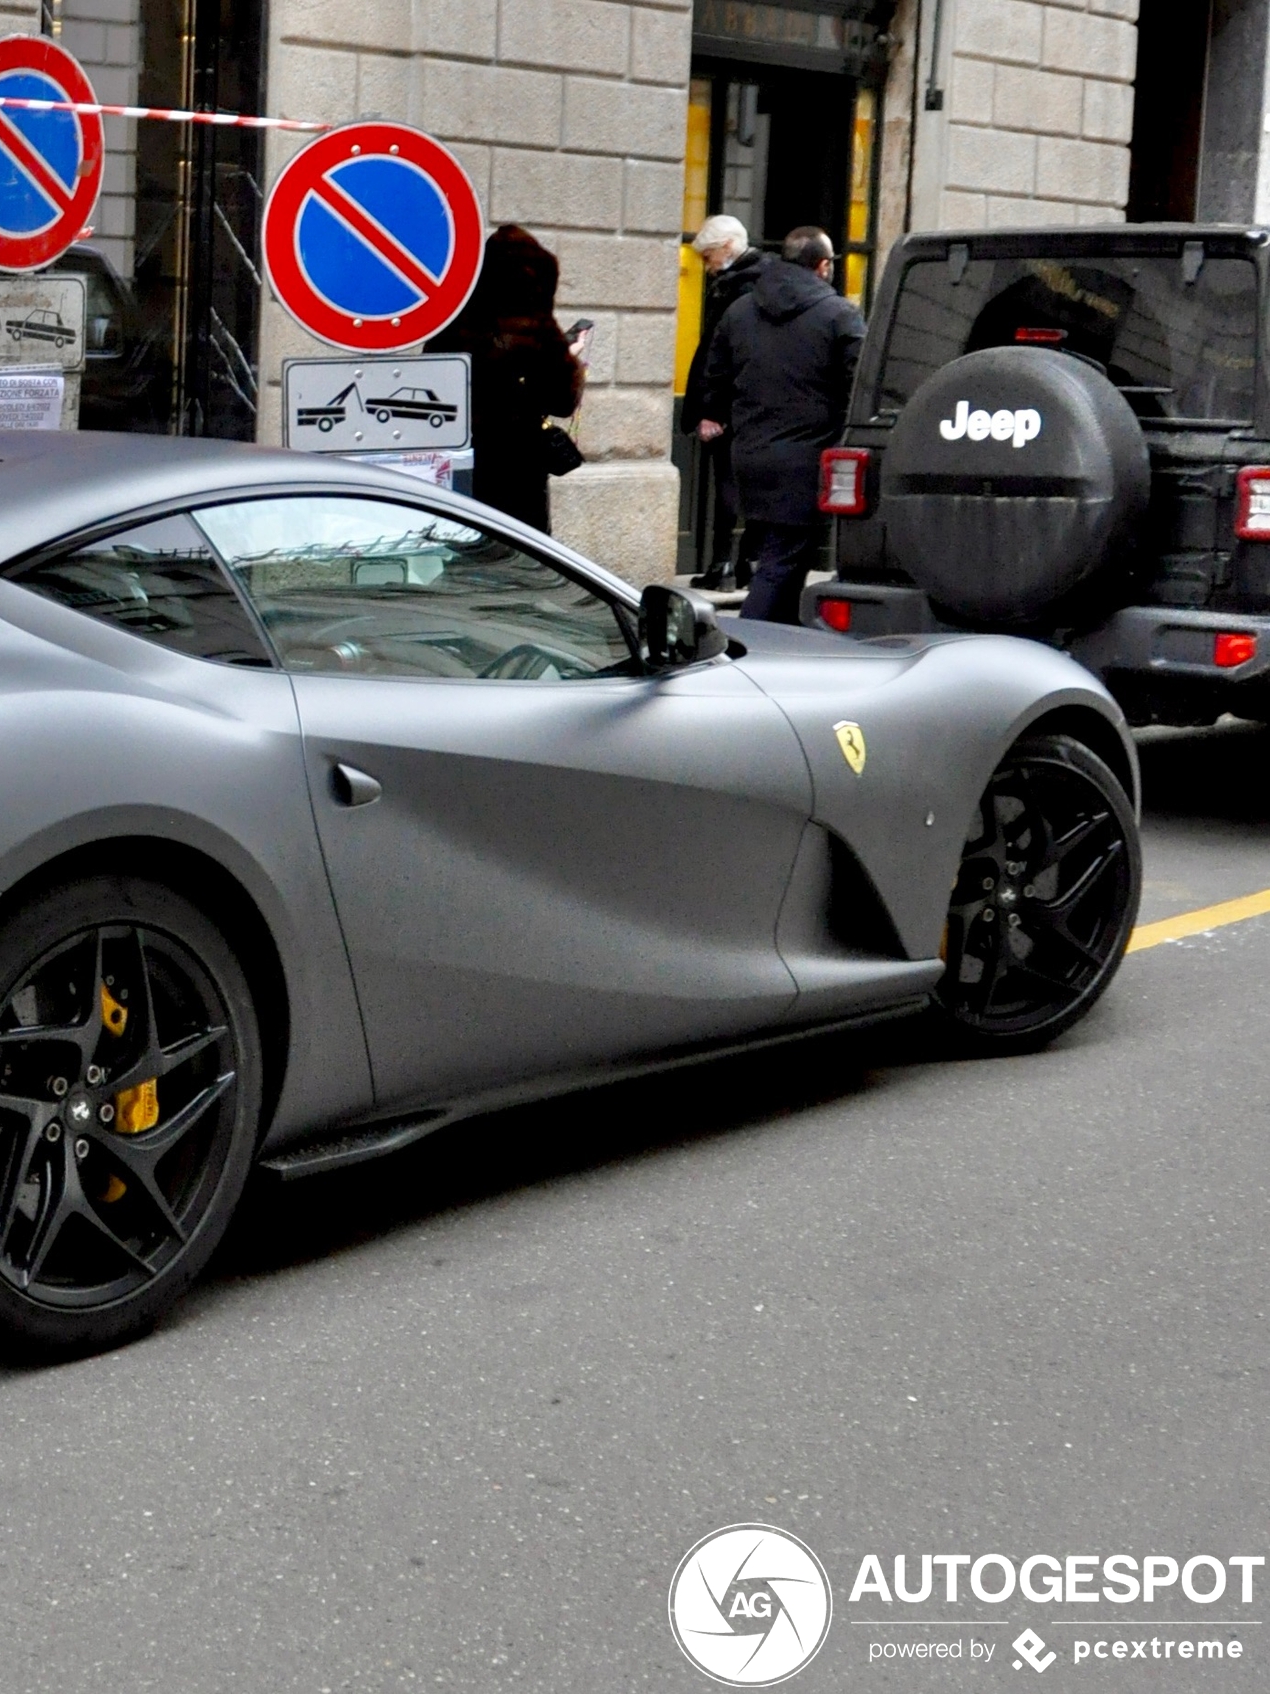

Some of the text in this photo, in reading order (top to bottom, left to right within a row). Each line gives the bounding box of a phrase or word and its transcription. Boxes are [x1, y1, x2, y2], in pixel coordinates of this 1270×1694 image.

[18, 379, 42, 387] SOSTA
[24, 388, 60, 398] FORZATA
[939, 400, 1042, 448] Jeep
